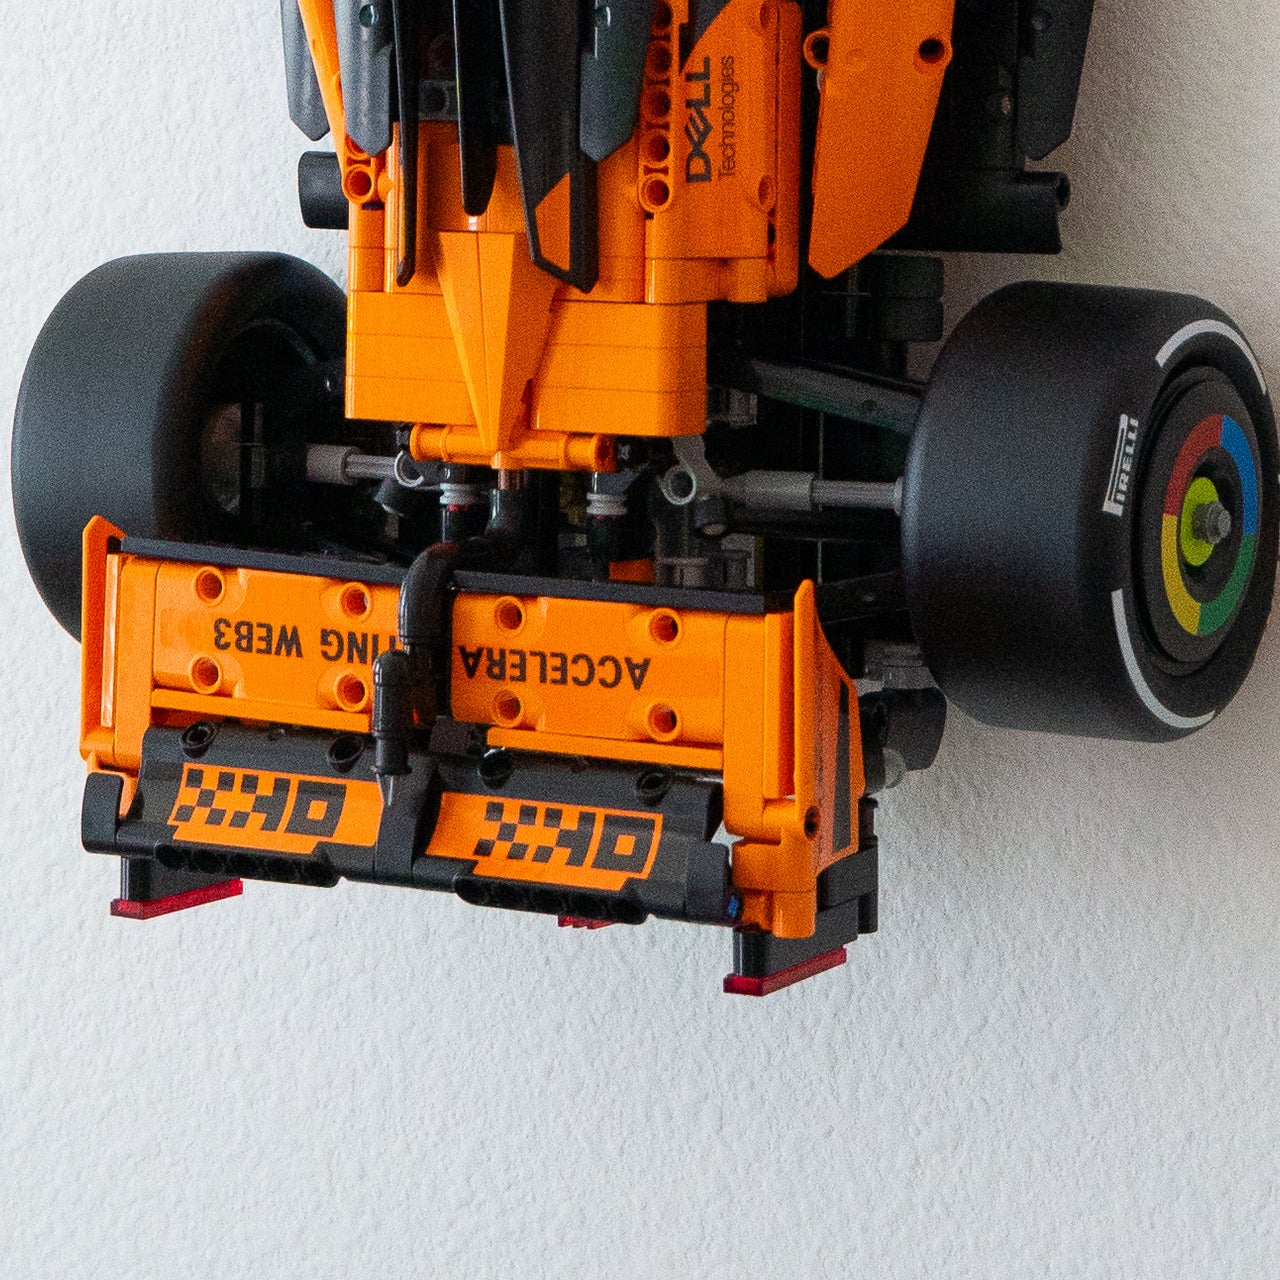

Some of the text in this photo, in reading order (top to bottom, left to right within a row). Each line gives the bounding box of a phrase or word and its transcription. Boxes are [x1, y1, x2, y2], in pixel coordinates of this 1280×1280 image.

[685, 56, 713, 183] DELL
[718, 54, 740, 181] Technologies
[1102, 413, 1140, 517] PIRELLI
[214, 617, 304, 658] WEB3
